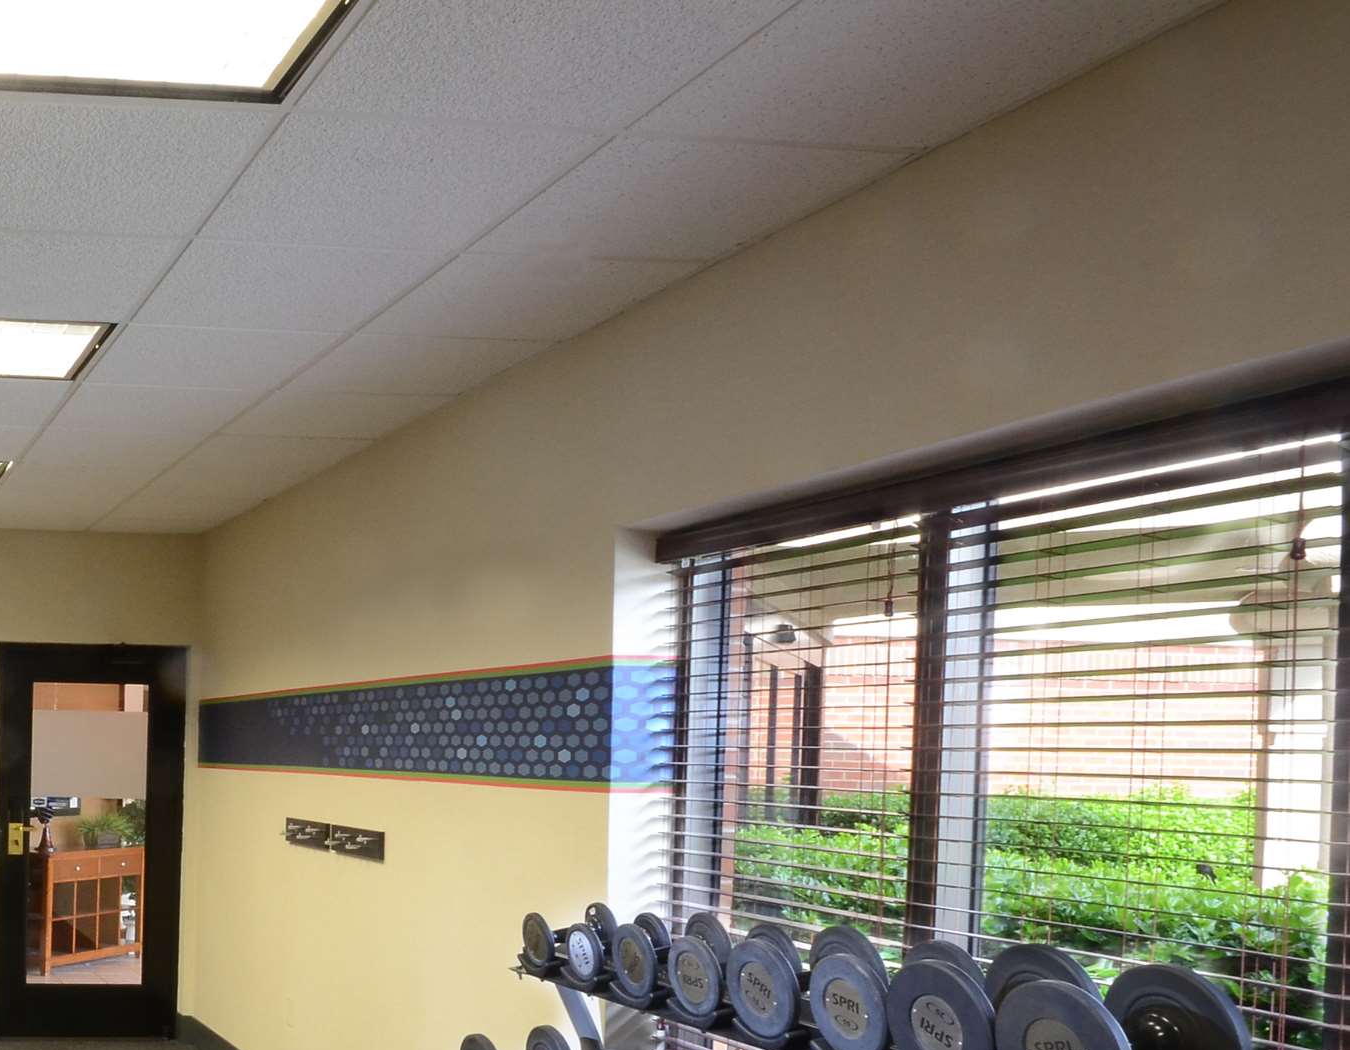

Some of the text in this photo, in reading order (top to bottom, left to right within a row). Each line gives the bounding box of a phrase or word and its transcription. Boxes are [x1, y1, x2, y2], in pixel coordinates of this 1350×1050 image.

[747, 972, 771, 998] SPRI
[832, 993, 860, 1014] SPRI
[920, 1016, 953, 1048] SPRI
